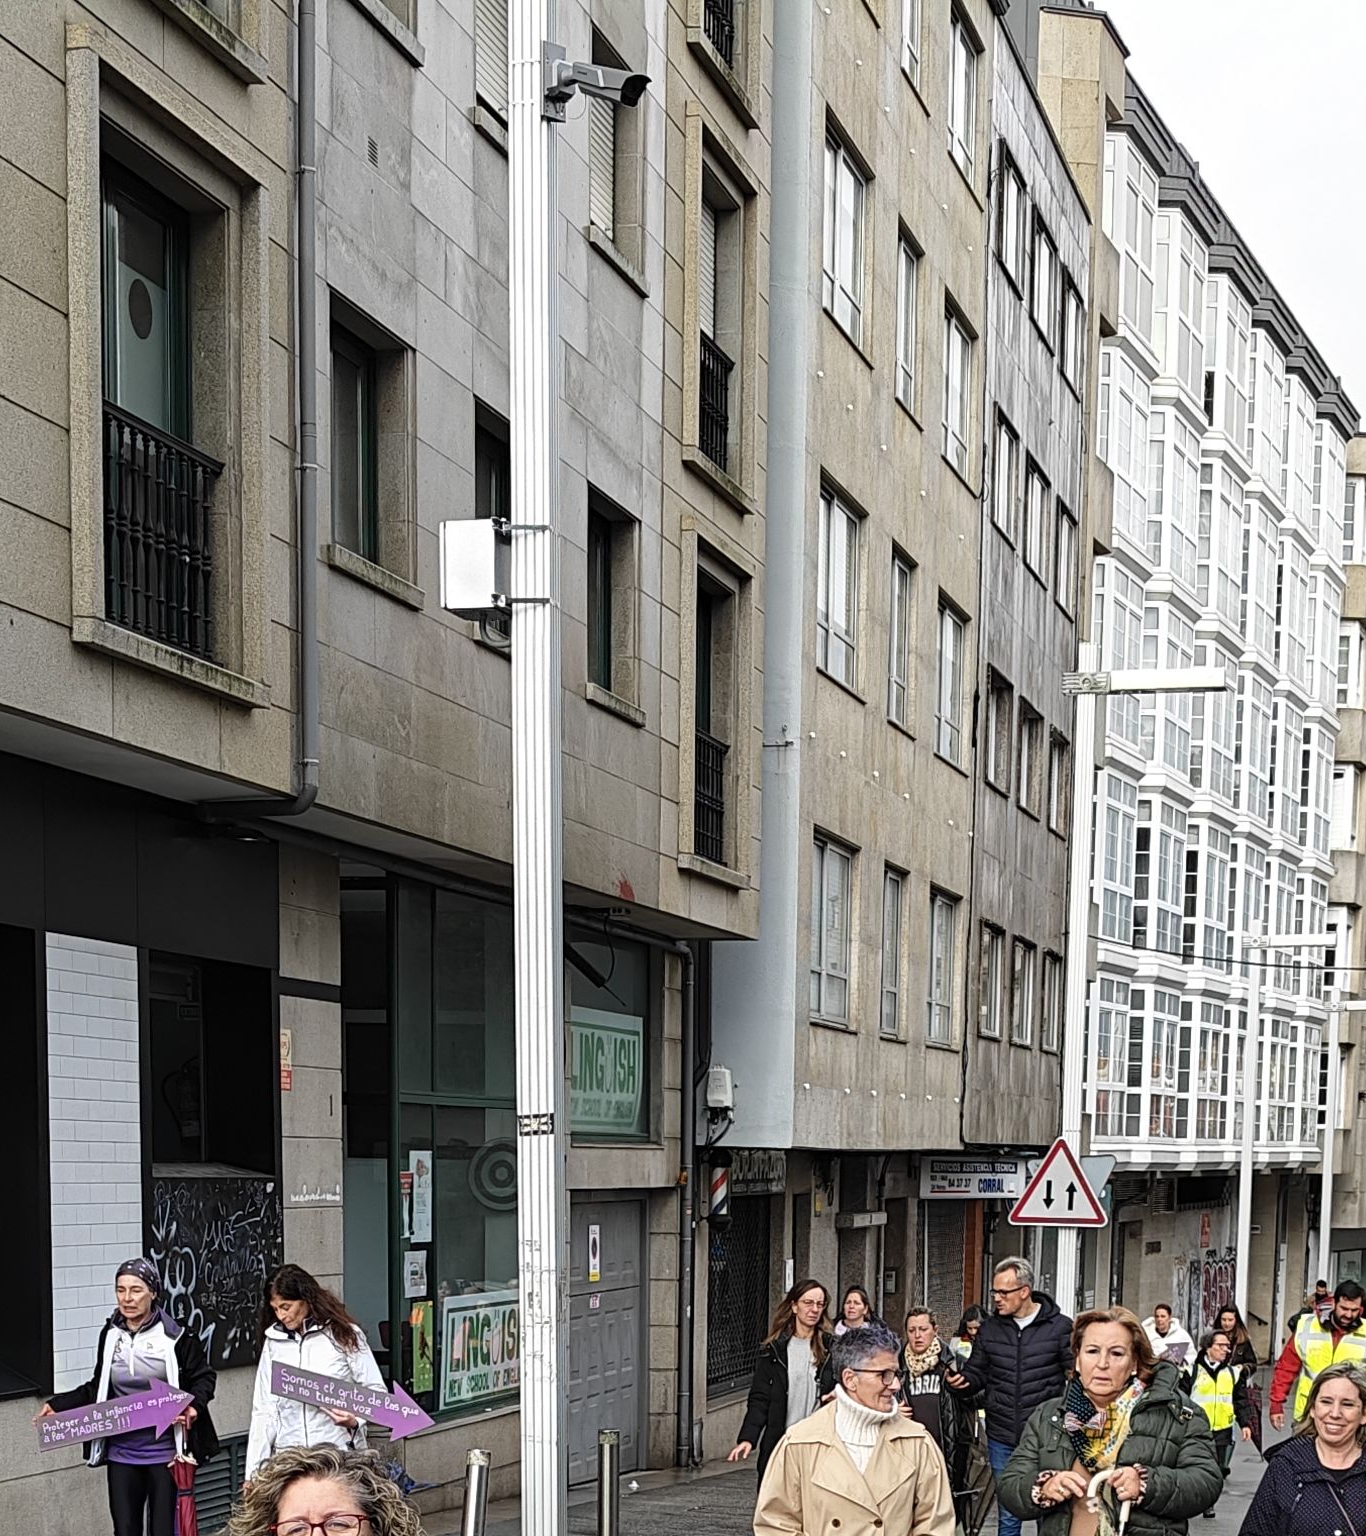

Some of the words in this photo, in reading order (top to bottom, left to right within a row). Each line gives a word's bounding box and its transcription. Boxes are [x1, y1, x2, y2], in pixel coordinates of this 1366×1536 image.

[963, 1162, 993, 1172] ASISTENCIA
[978, 1178, 1005, 1193] CORRAL
[281, 1369, 320, 1391] Somos
[323, 1382, 335, 1394] el
[338, 1387, 365, 1402] grito
[368, 1393, 382, 1407] de
[385, 1397, 399, 1411] las
[402, 1406, 420, 1418] que
[466, 1372, 490, 1395] SCHOOL
[493, 1370, 501, 1388] OF
[281, 1382, 294, 1395] ya
[299, 1388, 311, 1397] no
[316, 1391, 347, 1409] tienen
[42, 1418, 79, 1434] Proteger
[93, 1410, 103, 1420] la
[106, 1402, 144, 1419] infancia
[158, 1391, 188, 1408] proteger
[71, 1419, 113, 1438] MADRES
